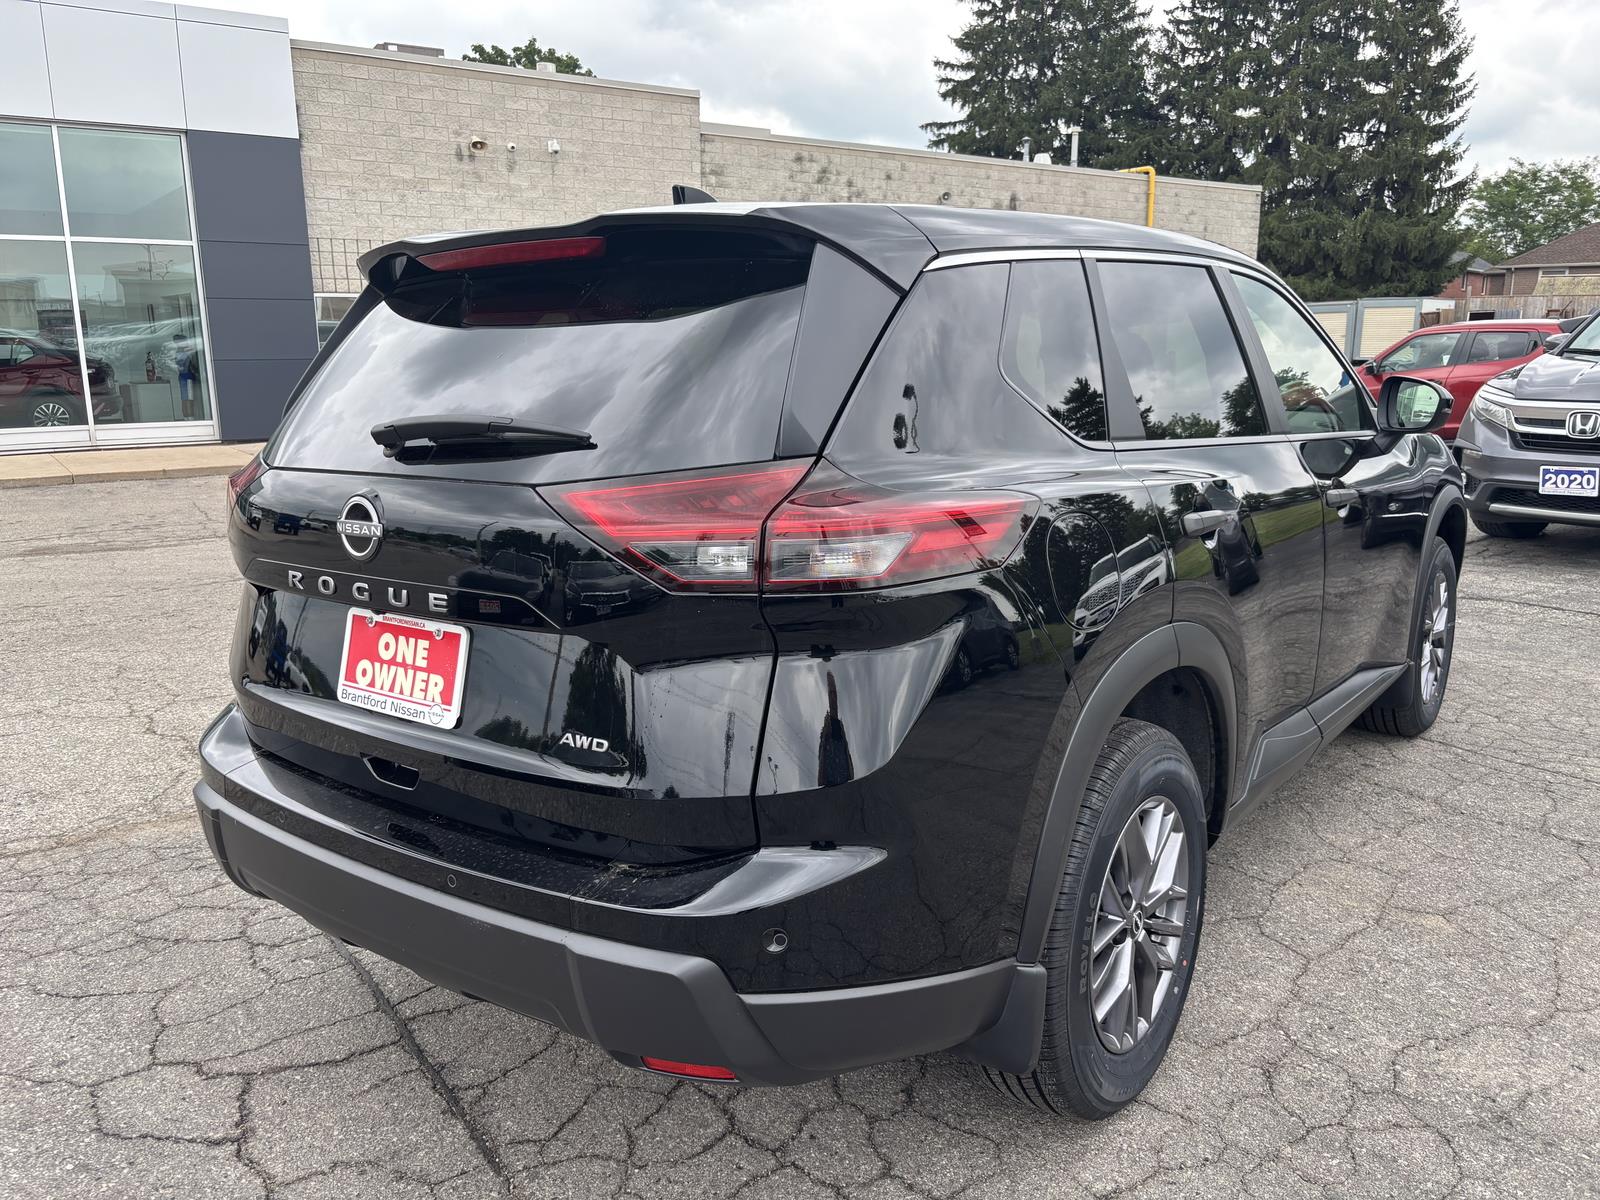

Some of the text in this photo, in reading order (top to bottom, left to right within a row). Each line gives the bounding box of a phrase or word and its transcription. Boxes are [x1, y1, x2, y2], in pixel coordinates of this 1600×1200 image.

[1544, 473, 1595, 489] 2020
[336, 522, 381, 536] NISSAN
[288, 570, 449, 613] ROGUE
[377, 632, 430, 668] ONE
[355, 658, 445, 704] OWNER
[341, 688, 426, 720] Brantford Nissan
[559, 732, 609, 752] AWD
[1080, 892, 1097, 994] ROVELO
